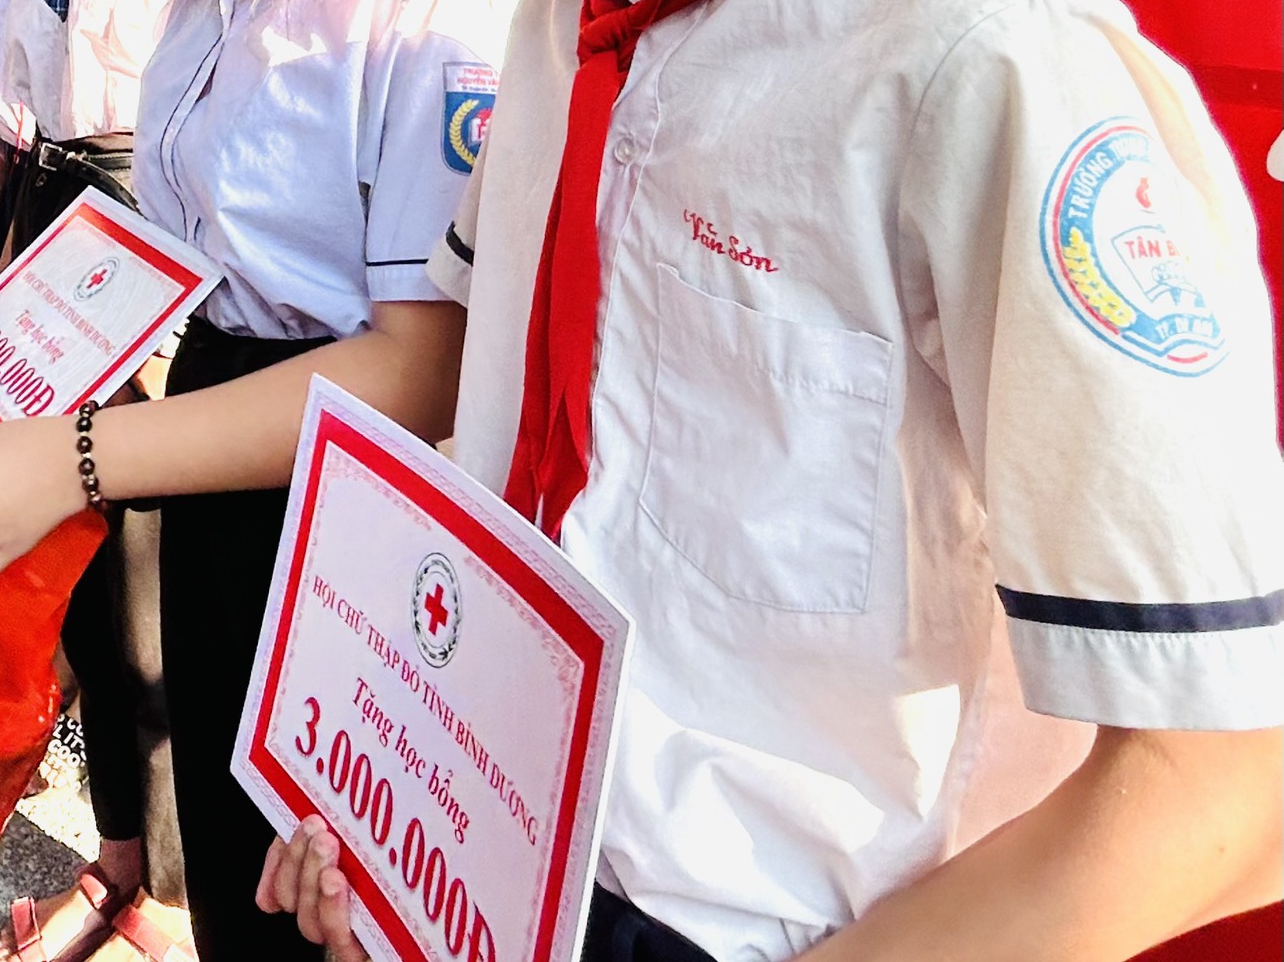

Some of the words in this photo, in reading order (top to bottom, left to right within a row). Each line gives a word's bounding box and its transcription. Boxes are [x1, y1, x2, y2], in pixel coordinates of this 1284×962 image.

[313, 575, 337, 610] HỘI
[337, 599, 367, 635] CHỮ
[352, 676, 394, 748] Tặng
[395, 725, 426, 778] học
[428, 762, 470, 845] bổng
